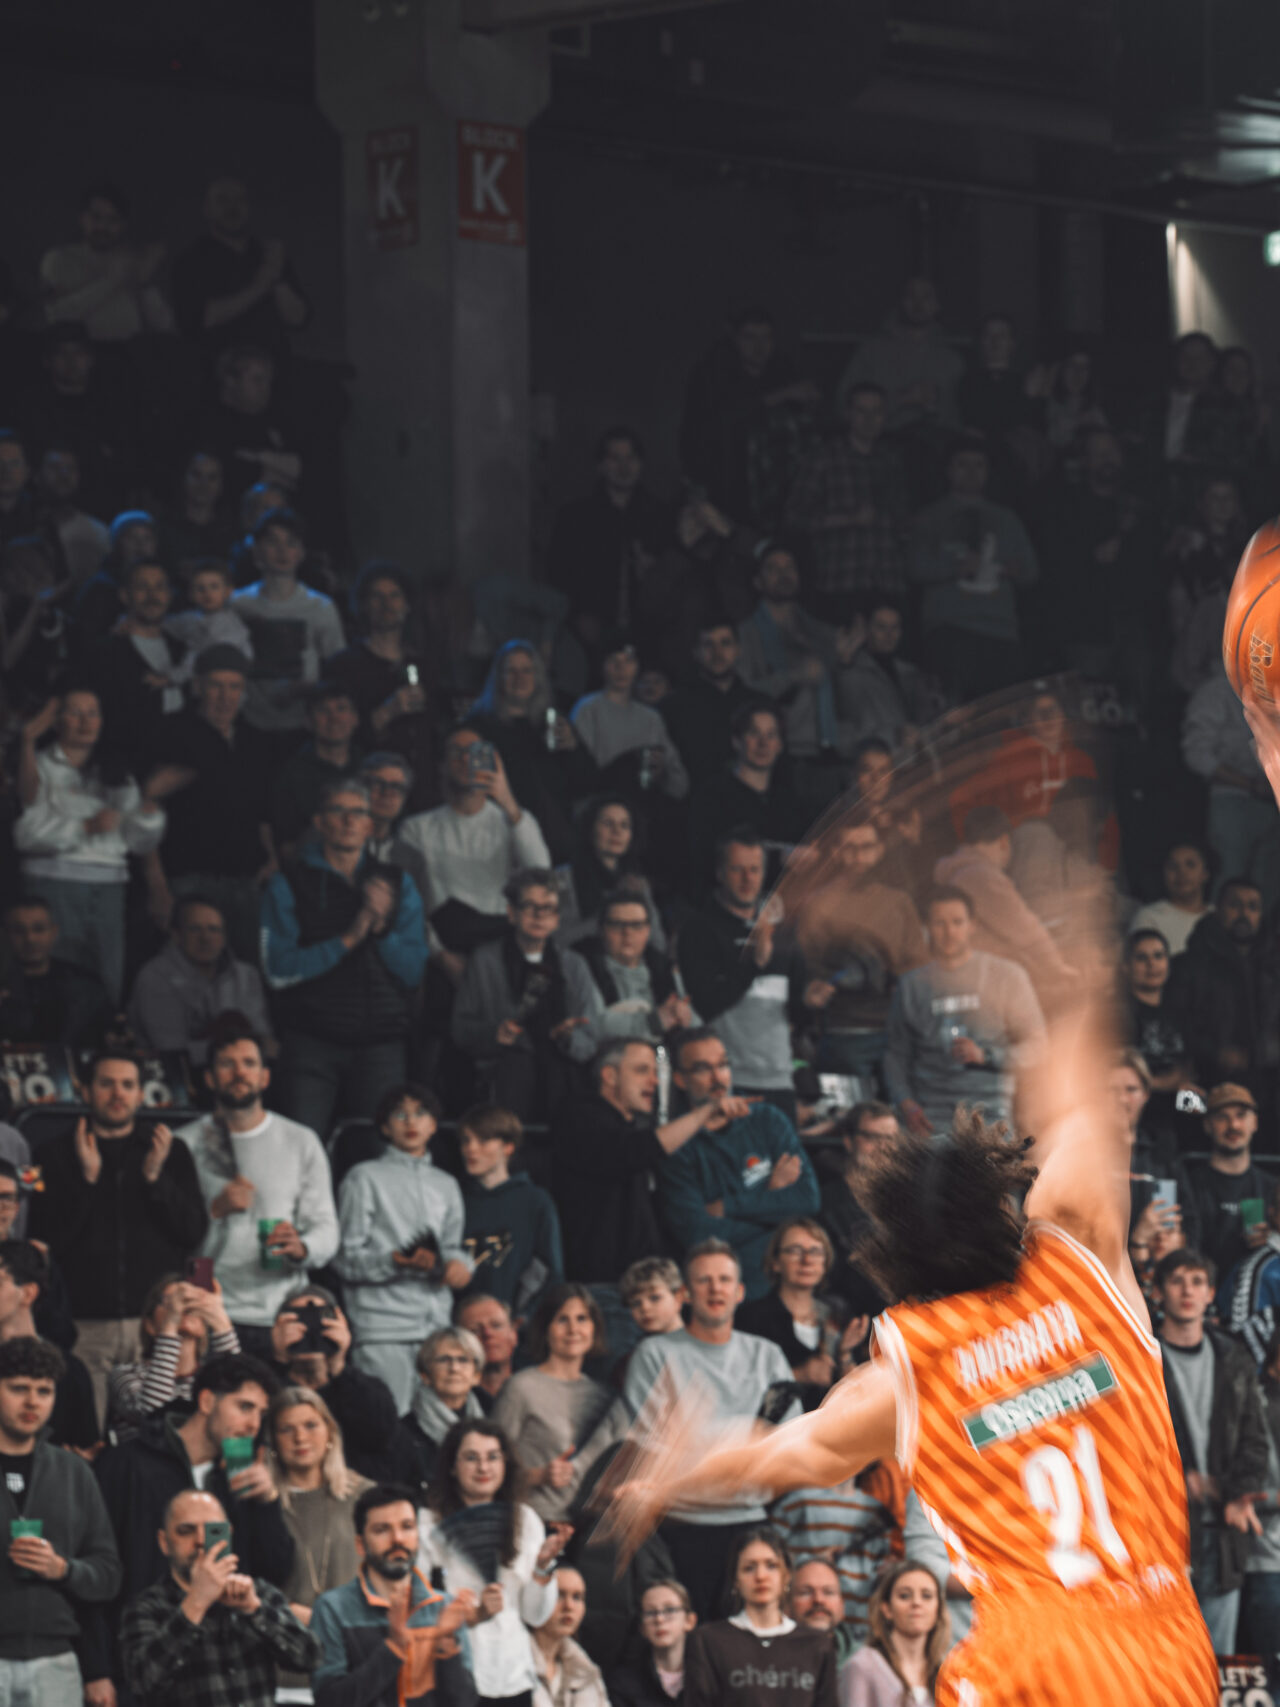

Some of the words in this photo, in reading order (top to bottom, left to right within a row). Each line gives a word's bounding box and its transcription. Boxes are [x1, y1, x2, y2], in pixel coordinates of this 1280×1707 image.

[378, 157, 406, 219] K
[473, 151, 510, 215] K
[1025, 1423, 1132, 1591] 21
[729, 1663, 816, 1690] chérie
